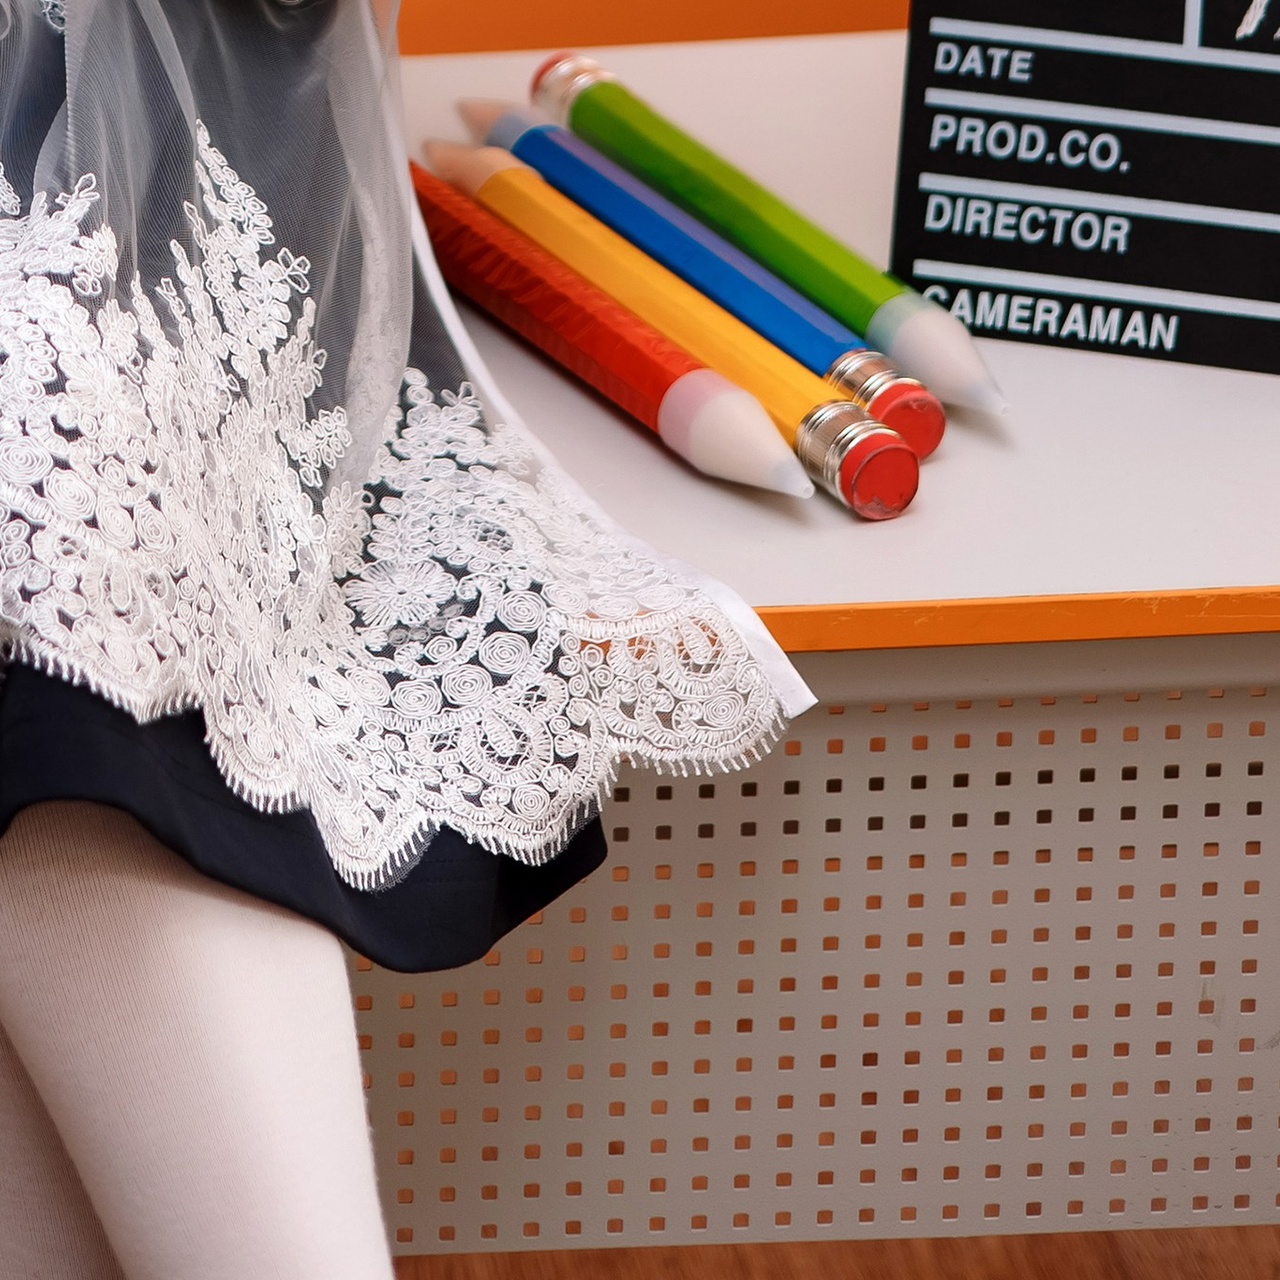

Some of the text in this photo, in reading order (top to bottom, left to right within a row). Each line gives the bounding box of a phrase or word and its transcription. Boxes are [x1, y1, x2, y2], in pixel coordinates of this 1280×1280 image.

[934, 42, 1035, 82] DATE
[929, 113, 1132, 174] PROD.CO.
[924, 194, 1132, 254] DIRECTOR
